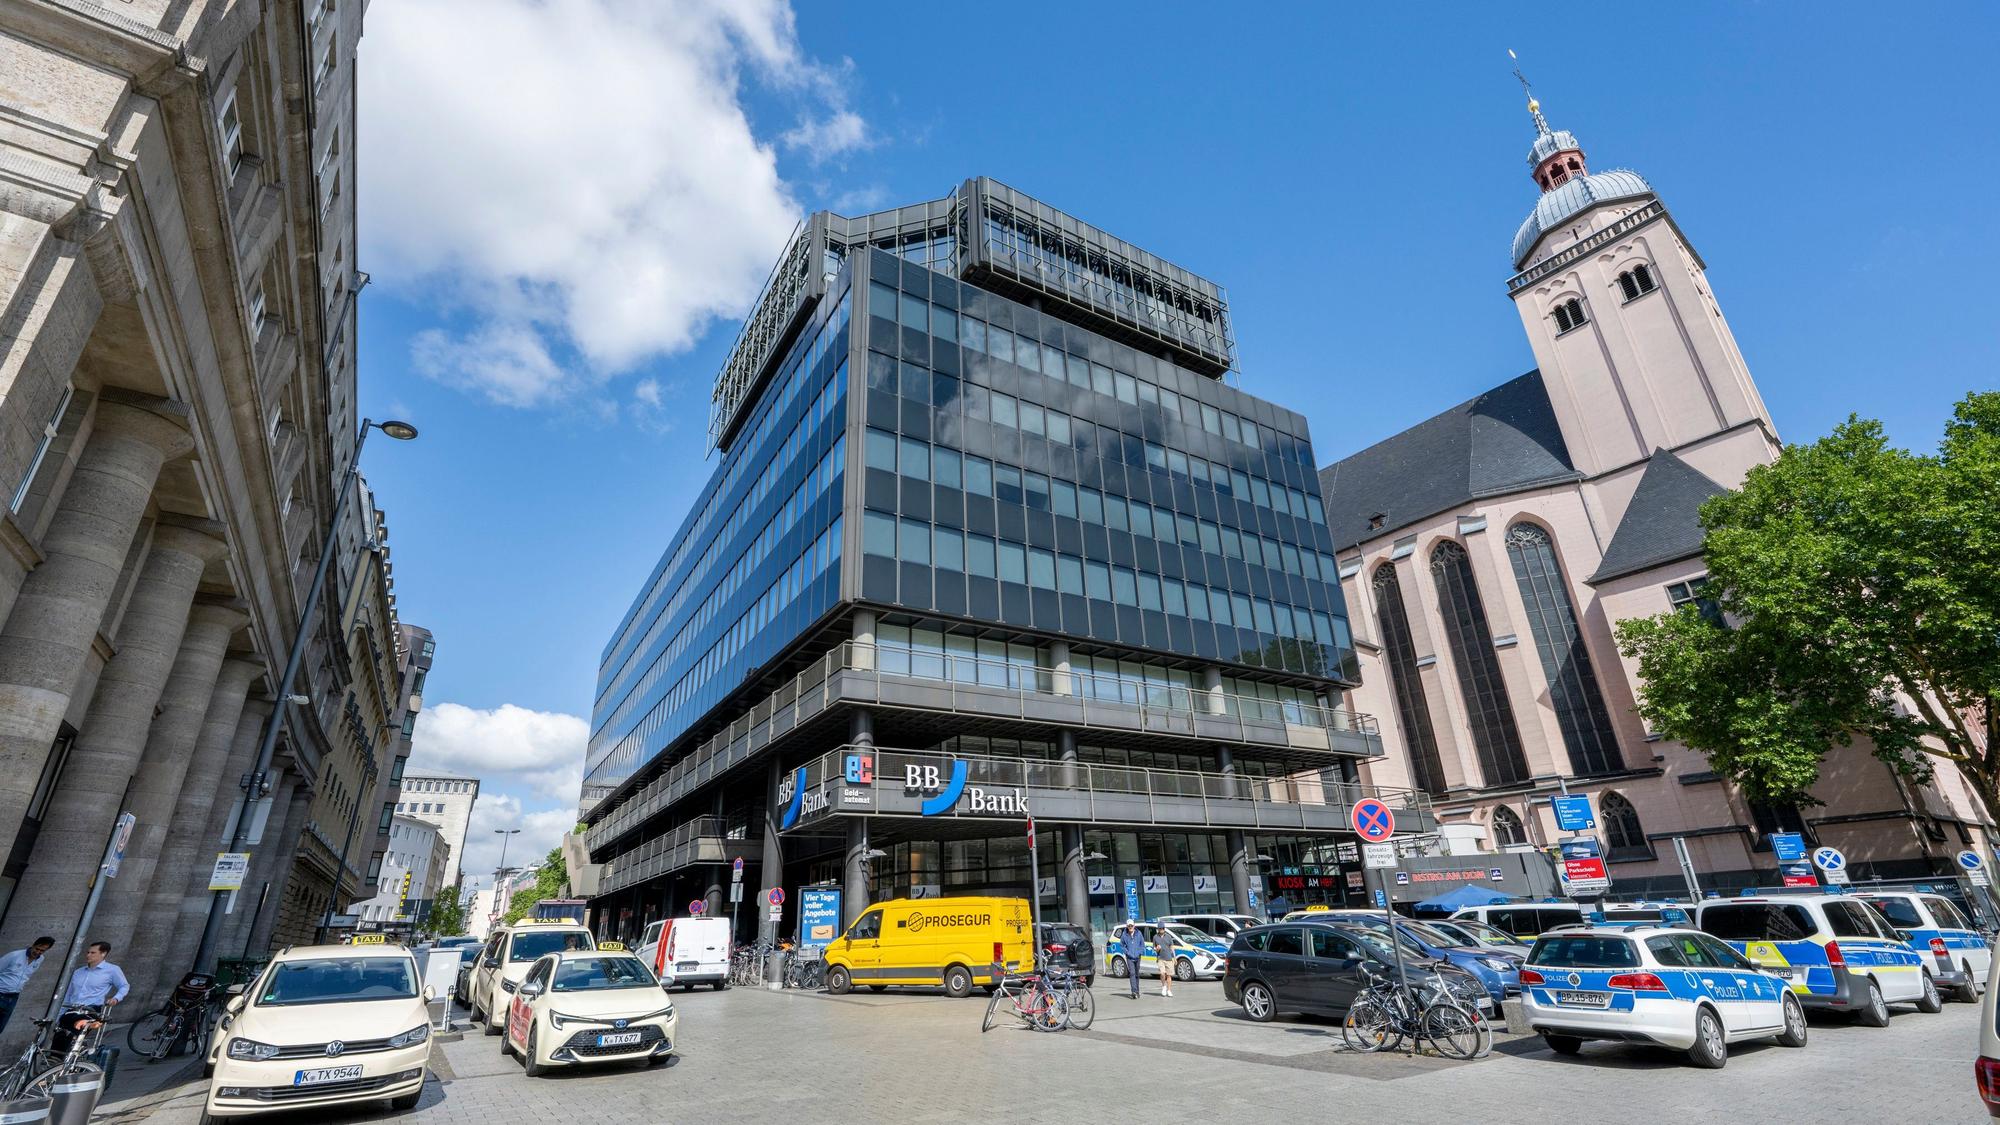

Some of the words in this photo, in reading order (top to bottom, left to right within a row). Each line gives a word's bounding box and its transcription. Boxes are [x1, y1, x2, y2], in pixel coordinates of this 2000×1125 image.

[905, 764, 940, 788] BB
[969, 787, 1029, 812] Bank
[844, 789, 864, 797] Geld-
[778, 780, 792, 806] BB
[800, 782, 828, 816] Bank
[844, 796, 870, 804] automat
[1586, 820, 1594, 828] P
[1446, 871, 1461, 881] AM
[1279, 876, 1304, 888] KIOSK
[1308, 878, 1319, 887] AM
[400, 873, 411, 907] HOTEL
[1131, 887, 1136, 895] P
[805, 893, 819, 901] Vier
[820, 893, 835, 902] Tage
[805, 901, 823, 909] voller
[804, 909, 836, 918] Angebote
[925, 913, 991, 928] PROSEGUR
[361, 935, 380, 943] TAXI
[605, 942, 622, 950] TAXI
[1714, 986, 1739, 998] POLIZEI
[604, 1036, 609, 1044] K
[615, 1035, 623, 1043] TX
[624, 1034, 638, 1042] 677
[302, 1072, 310, 1082] K
[318, 1070, 332, 1080] TX
[334, 1067, 360, 1079] 9544
